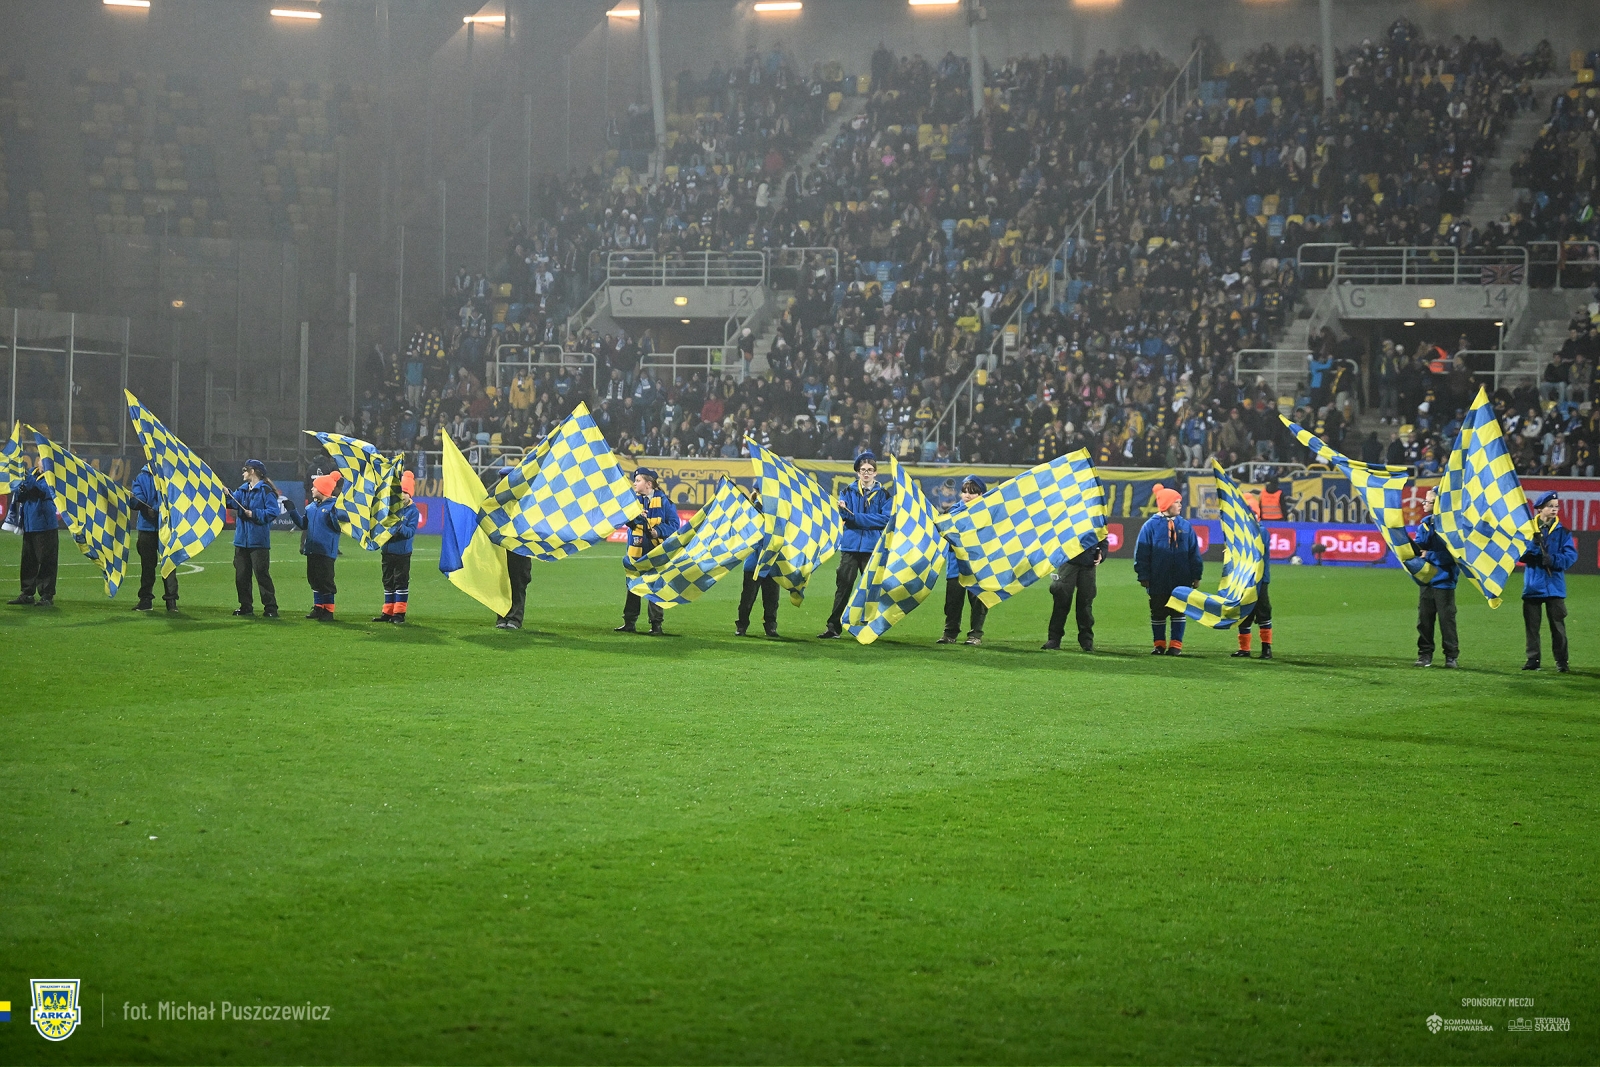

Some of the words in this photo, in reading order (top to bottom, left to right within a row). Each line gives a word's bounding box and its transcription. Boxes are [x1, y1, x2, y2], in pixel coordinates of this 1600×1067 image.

[620, 288, 633, 307] G
[728, 288, 749, 308] 13
[1350, 287, 1366, 308] G
[1483, 288, 1508, 308] 14
[1320, 535, 1381, 553] Duda
